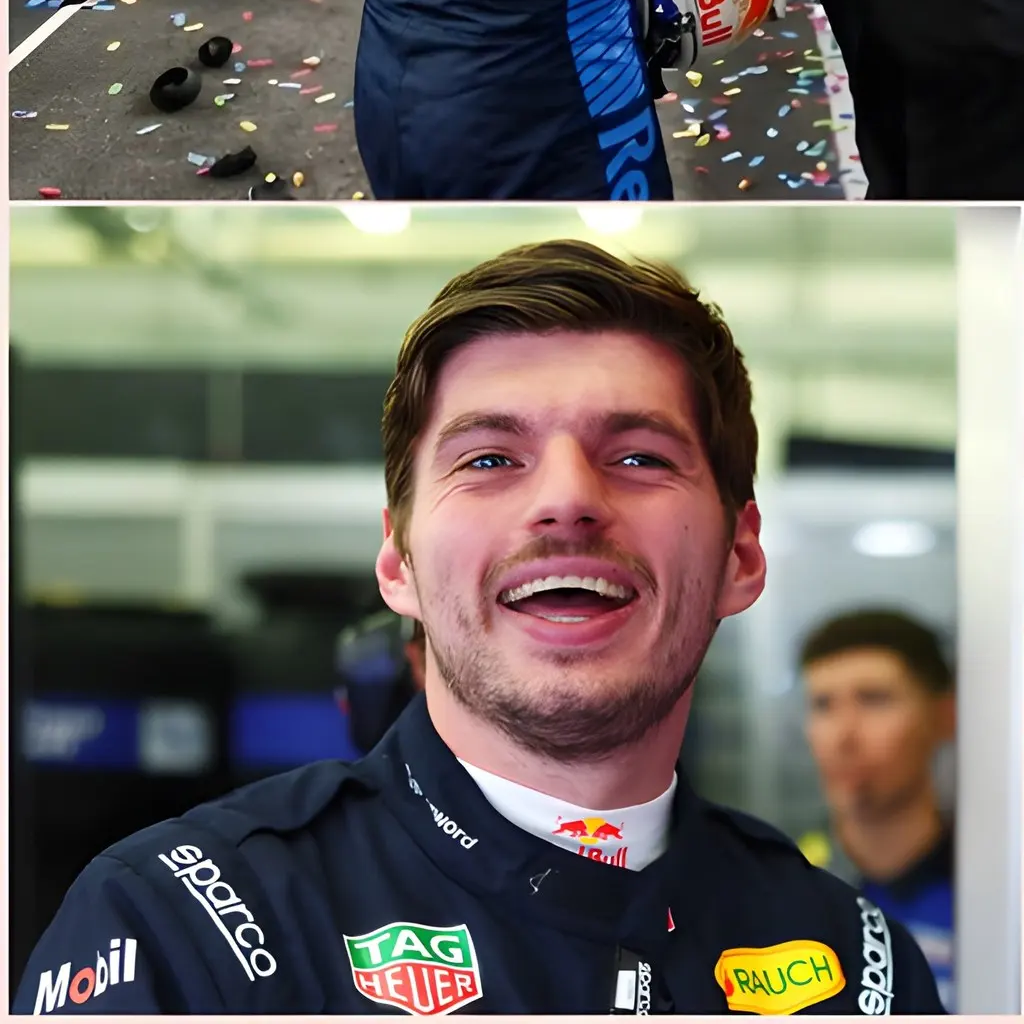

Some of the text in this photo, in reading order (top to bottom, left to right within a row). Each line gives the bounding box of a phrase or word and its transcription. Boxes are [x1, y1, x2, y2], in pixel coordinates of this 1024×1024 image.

[167, 845, 277, 979] sparco
[354, 929, 464, 965] TAG
[33, 938, 138, 1016] Mobil
[358, 965, 473, 1014] HEUER
[733, 954, 834, 997] RAUCH
